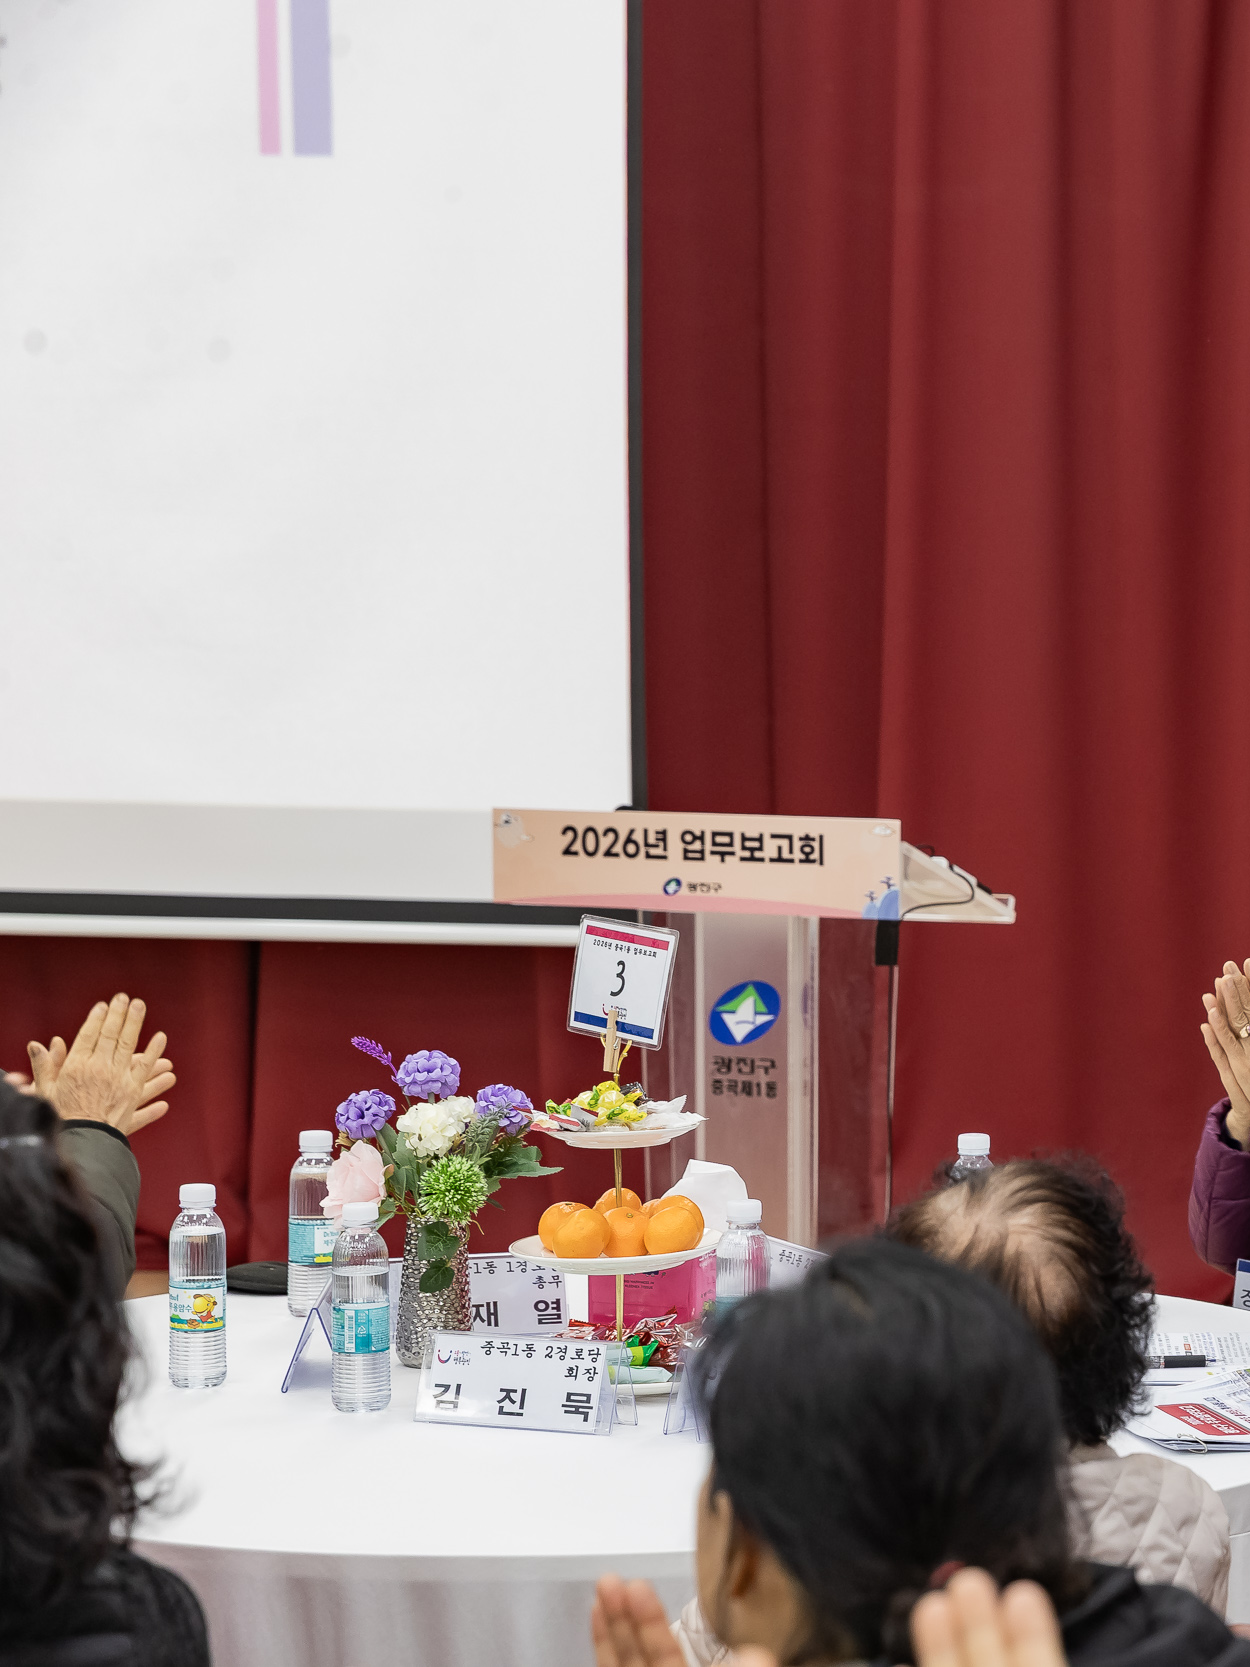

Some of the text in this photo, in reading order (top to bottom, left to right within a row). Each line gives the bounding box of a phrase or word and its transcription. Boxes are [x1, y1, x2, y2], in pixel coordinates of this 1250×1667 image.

[561, 826, 825, 866] 2026년 업무보고회
[609, 960, 625, 997] 3
[712, 1055, 776, 1076] 광진구
[469, 1261, 557, 1274] 1동 1경
[532, 1275, 562, 1289] 총무
[481, 1341, 536, 1358] 중곡1동
[544, 1345, 602, 1363] 2경로당
[564, 1365, 598, 1382] 회장
[433, 1383, 594, 1422] 김진묵
